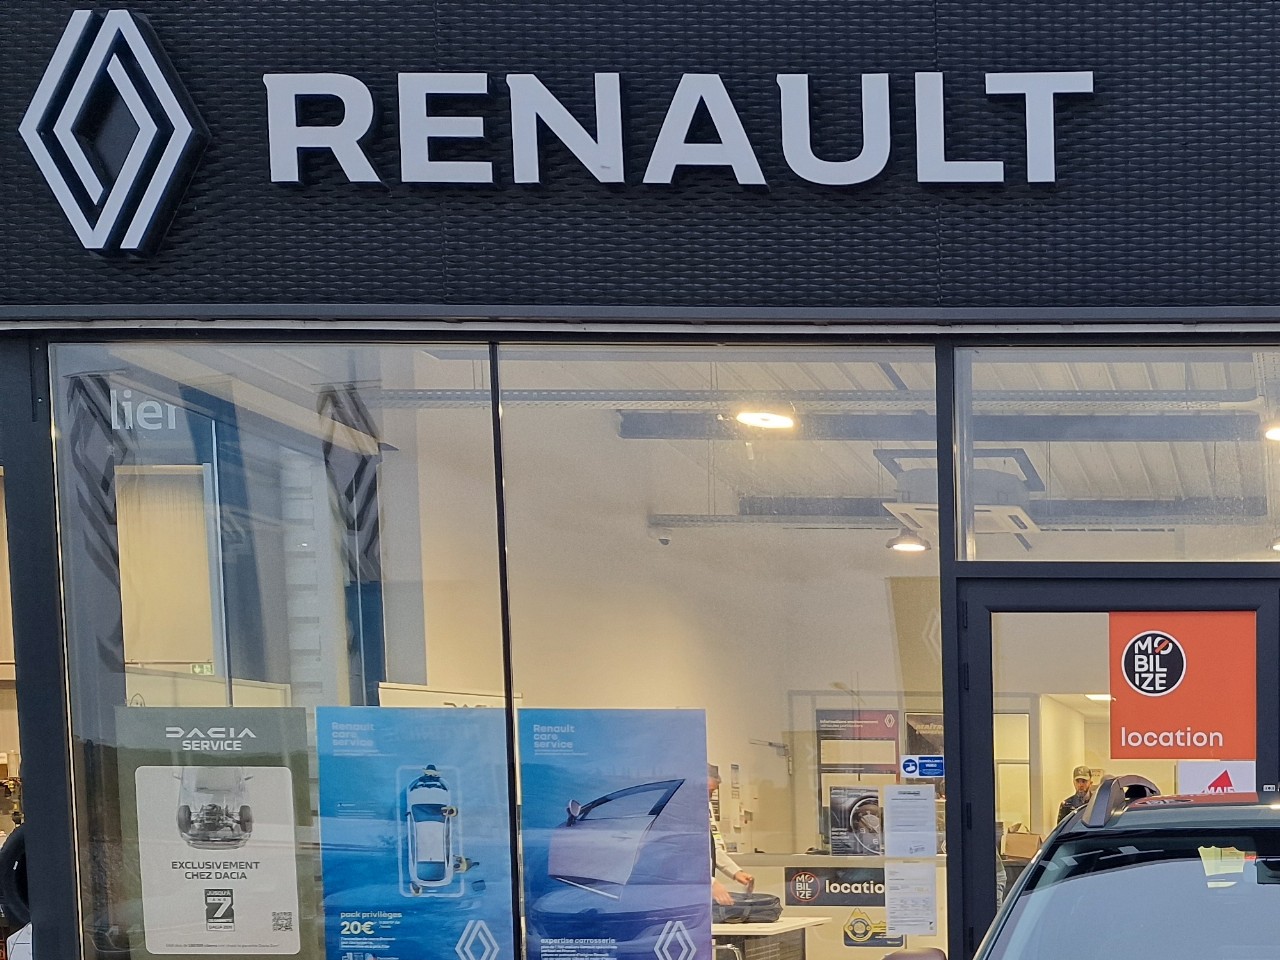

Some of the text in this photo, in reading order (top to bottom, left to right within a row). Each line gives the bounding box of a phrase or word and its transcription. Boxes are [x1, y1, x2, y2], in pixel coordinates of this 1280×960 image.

[263, 71, 1094, 187] RENAULT
[165, 727, 257, 738] DACIA
[533, 724, 575, 733] Renault
[1121, 727, 1223, 747] location
[182, 740, 242, 751] SERVICE
[533, 740, 573, 748] service
[171, 861, 260, 870] EXCLUSIVEMENT
[184, 871, 248, 880] CHEZ DACIA
[340, 911, 361, 919] pack
